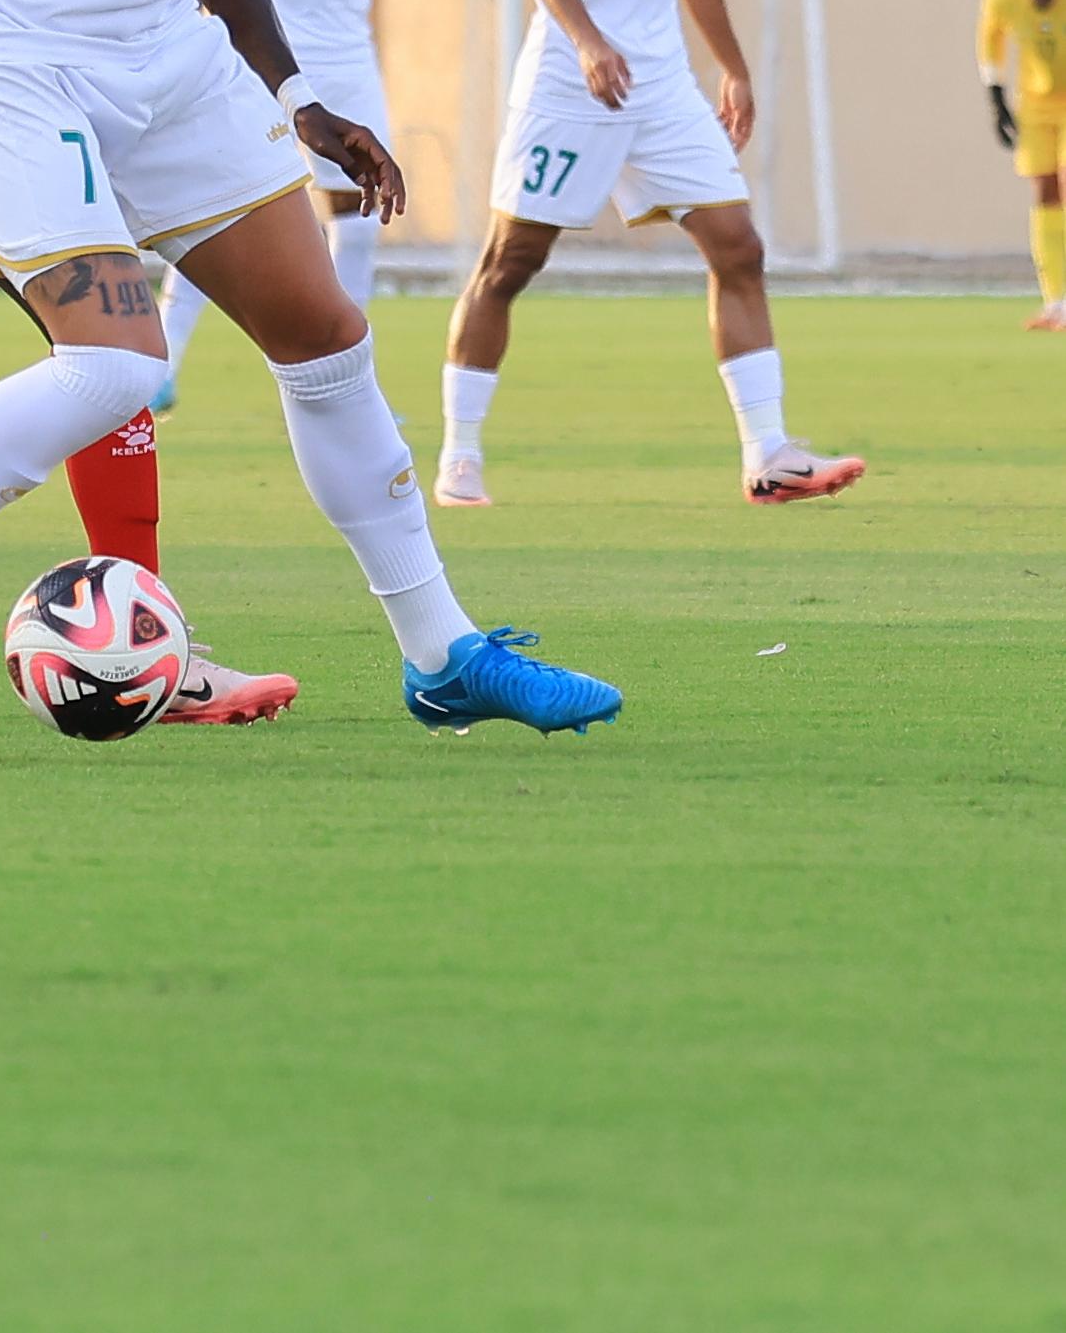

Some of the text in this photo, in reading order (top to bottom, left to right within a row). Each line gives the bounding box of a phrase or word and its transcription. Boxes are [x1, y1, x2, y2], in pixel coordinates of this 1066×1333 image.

[59, 129, 97, 205] 7
[522, 145, 579, 198] 37
[111, 441, 156, 457] KELM
